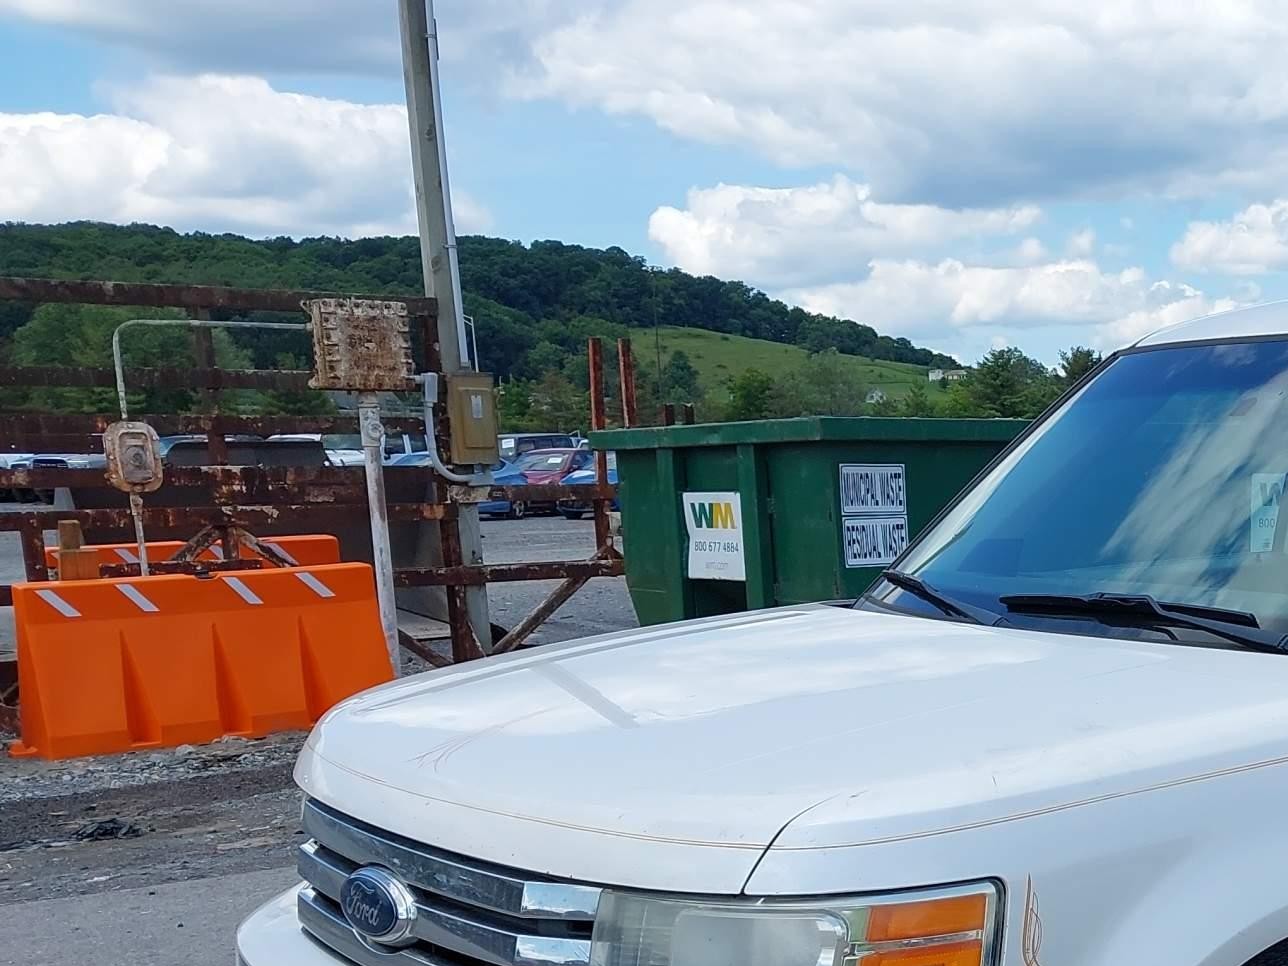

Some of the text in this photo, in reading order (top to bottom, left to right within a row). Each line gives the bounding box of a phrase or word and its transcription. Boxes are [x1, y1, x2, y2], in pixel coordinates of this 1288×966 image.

[843, 471, 902, 507] MUNICIPAL WASTE
[690, 502, 737, 529] WM
[694, 541, 707, 552] 800
[846, 523, 904, 559] RESIDUAL WASTE
[346, 880, 382, 927] Ford
